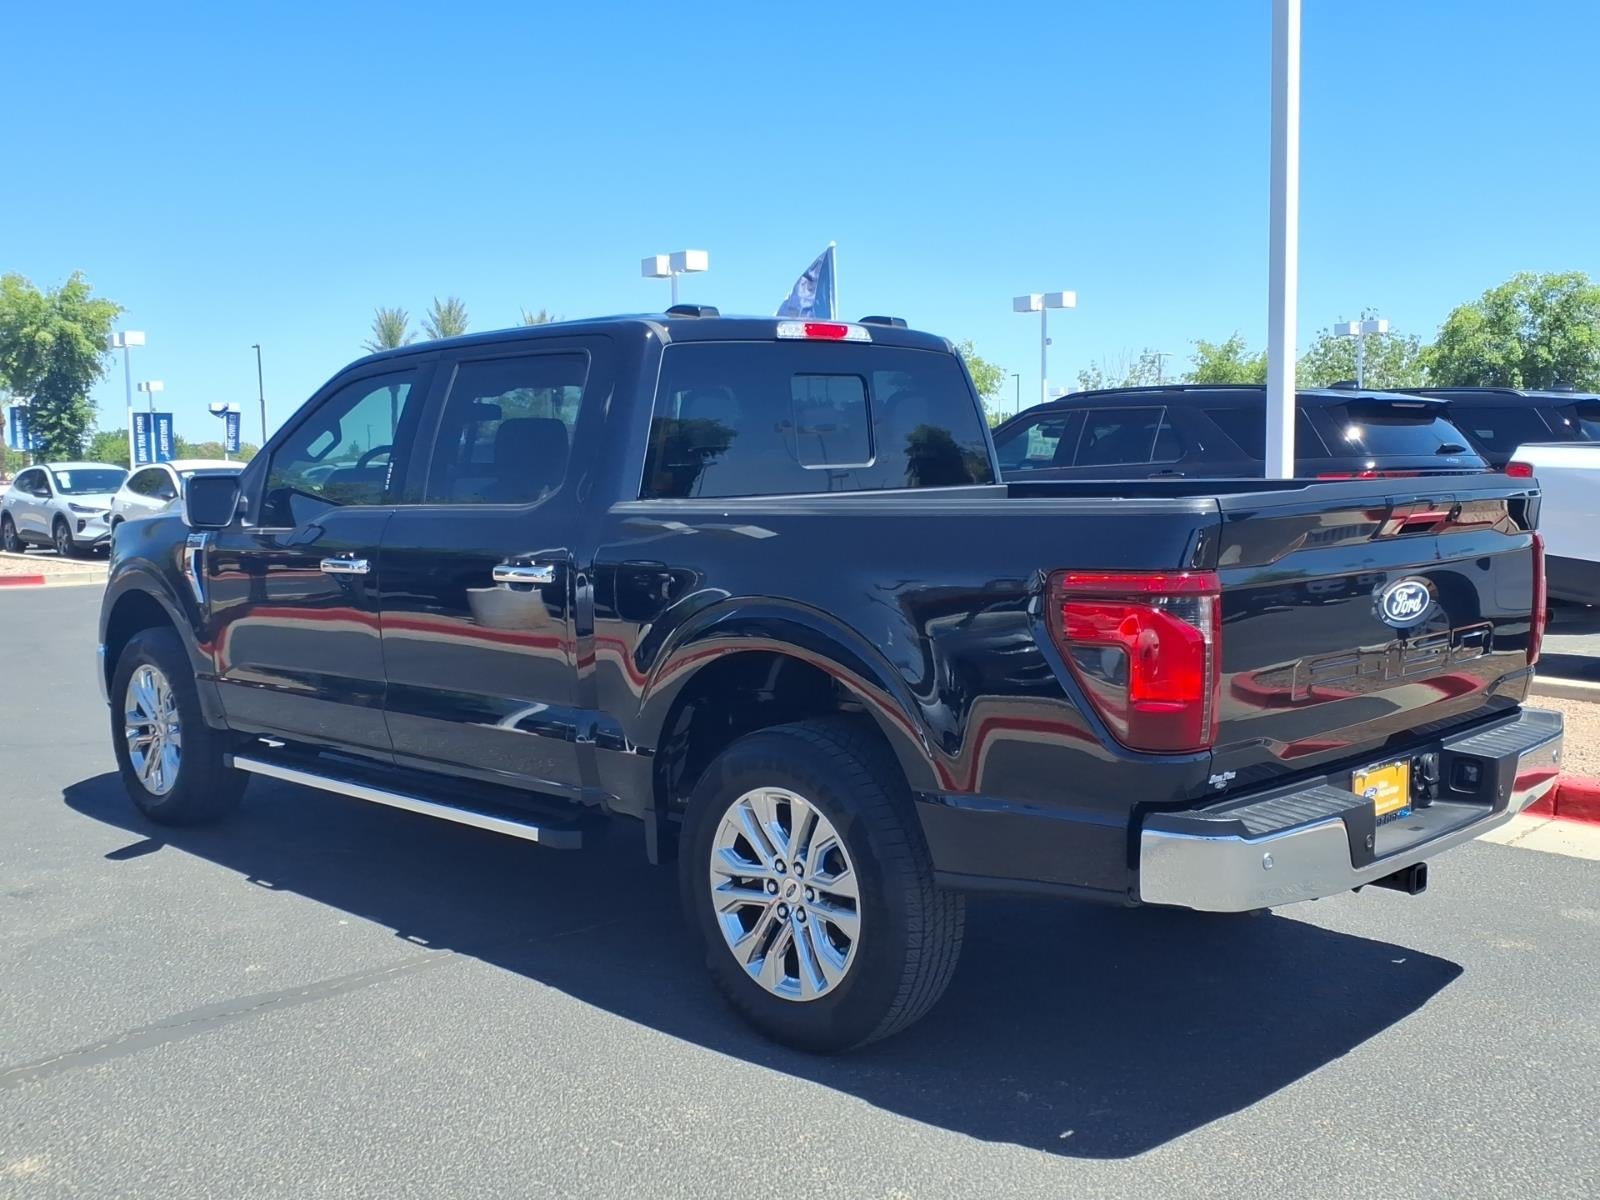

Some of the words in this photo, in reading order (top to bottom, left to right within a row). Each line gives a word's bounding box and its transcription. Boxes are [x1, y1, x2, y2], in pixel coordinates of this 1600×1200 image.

[136, 416, 145, 433] FORD
[137, 434, 146, 447] TAN
[159, 419, 169, 451] CUSTOMS
[138, 447, 147, 462] SAN
[1392, 588, 1423, 616] Ford
